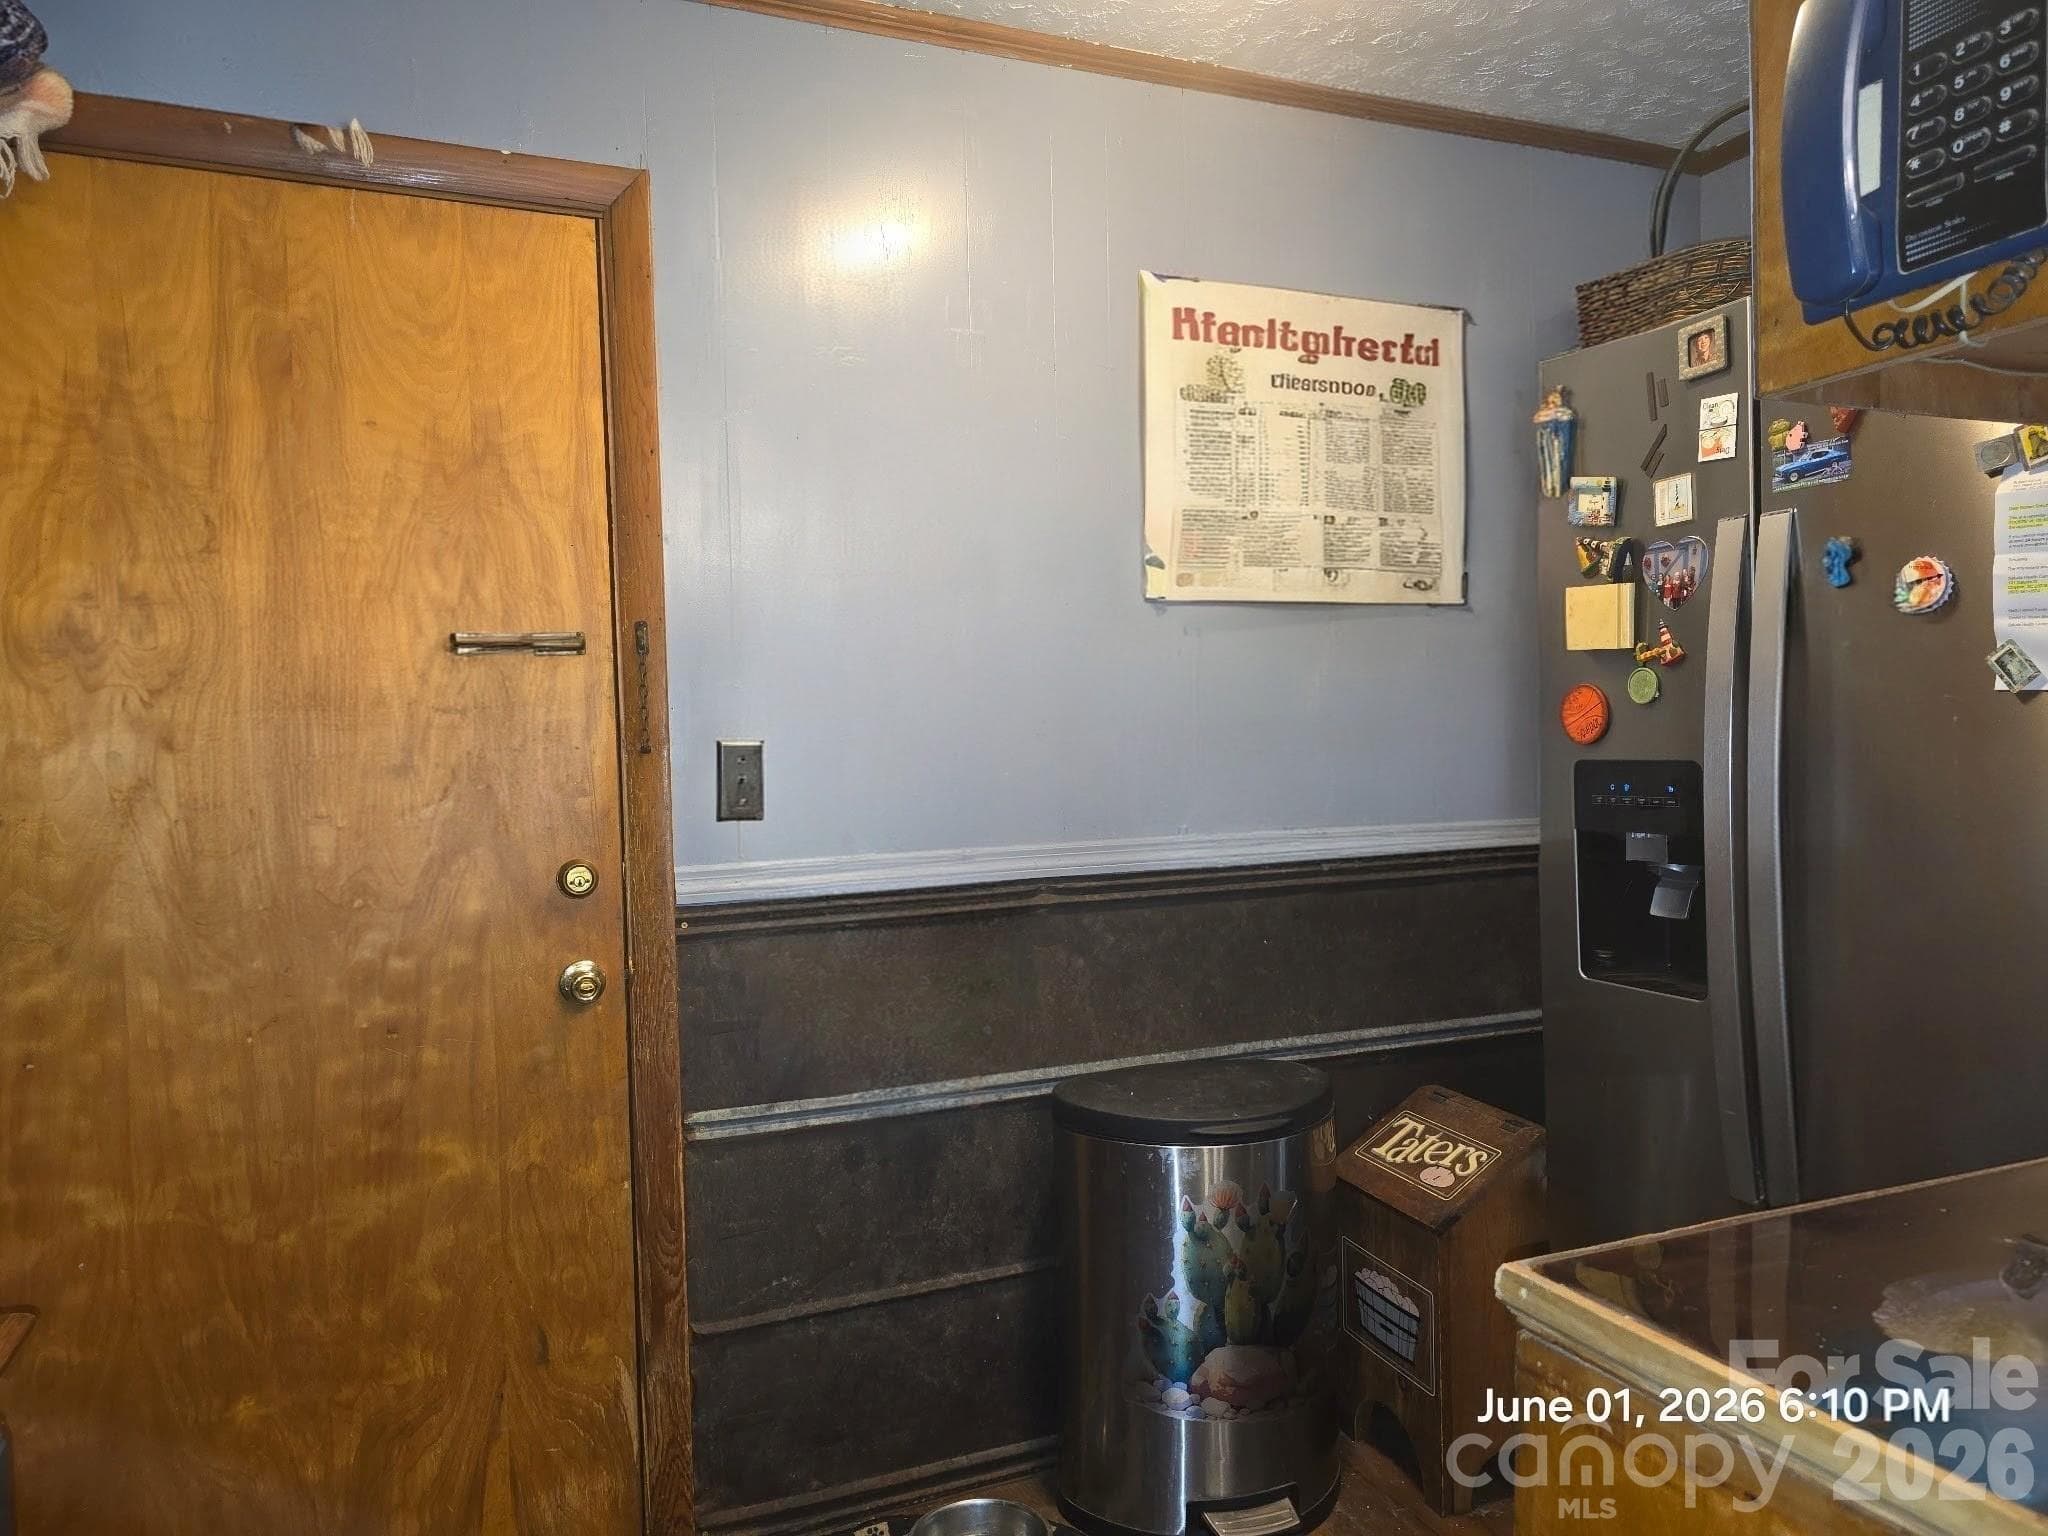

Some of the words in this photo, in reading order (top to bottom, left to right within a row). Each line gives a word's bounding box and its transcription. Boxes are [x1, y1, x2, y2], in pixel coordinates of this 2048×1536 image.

[2000, 19, 2011, 35] 3
[1955, 42, 1965, 56] 2
[1999, 53, 2011, 68] 6
[1913, 63, 1920, 77] 1
[1953, 74, 1965, 89] 5
[1910, 93, 1920, 107] 4
[2000, 86, 2012, 101] 9
[1910, 126, 1920, 140] 7
[1952, 140, 1964, 153] 0
[1372, 1116, 1489, 1177] Taters
